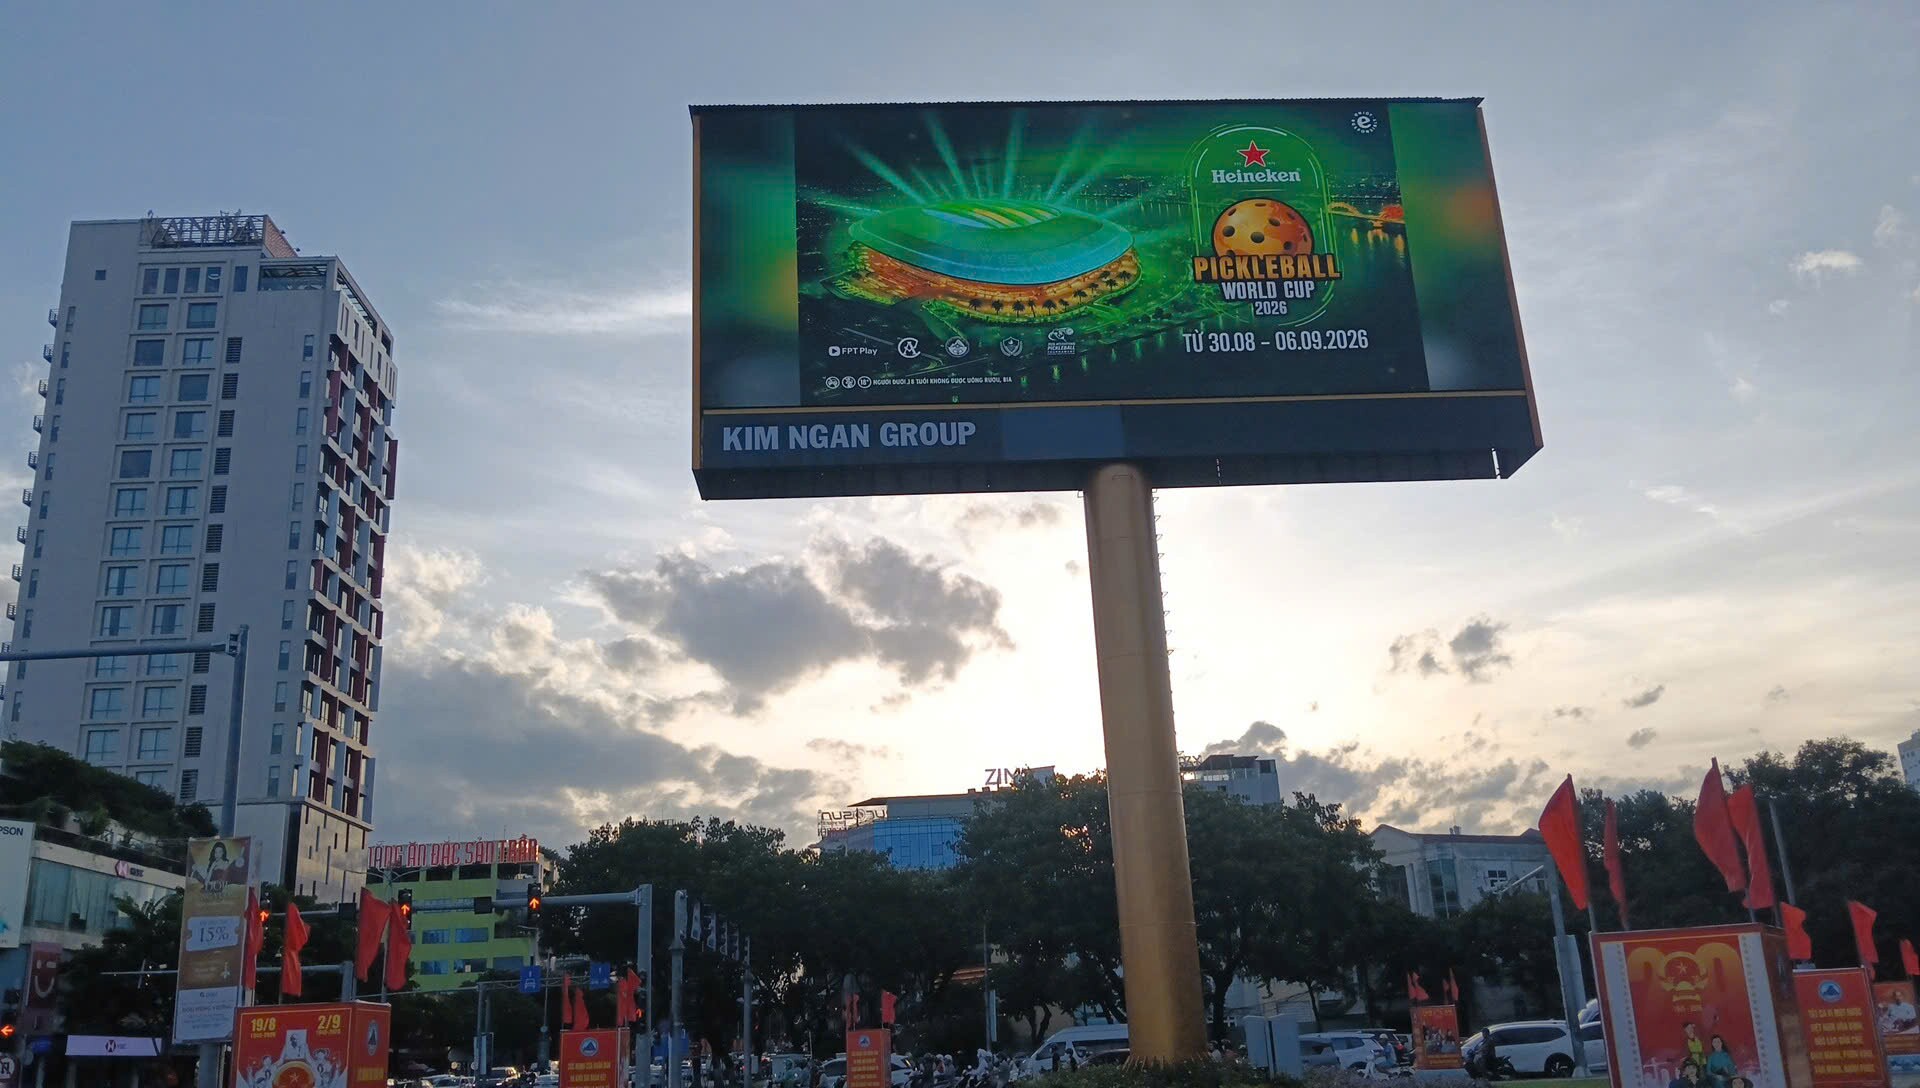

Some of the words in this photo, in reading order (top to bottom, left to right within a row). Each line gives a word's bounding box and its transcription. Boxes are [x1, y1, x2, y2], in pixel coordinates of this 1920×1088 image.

[1211, 168, 1301, 184] Heineken
[1193, 254, 1341, 281] PICKLEBALL
[1221, 281, 1276, 300] WORLD
[1284, 281, 1315, 299] CUP
[1255, 300, 1288, 315] 2026
[1182, 329, 1204, 353] TỪ
[1208, 331, 1256, 352] 30.08
[1275, 330, 1369, 351] 06.09.2026
[842, 347, 858, 355] FPT
[859, 347, 878, 358] Play
[723, 426, 779, 451] KIM
[788, 424, 870, 449] NGAN
[879, 422, 976, 447] GROUP
[0, 825, 24, 836] PSON
[199, 926, 229, 943] 15%
[251, 1017, 277, 1032] 19/8
[317, 1014, 341, 1029] 2/9
